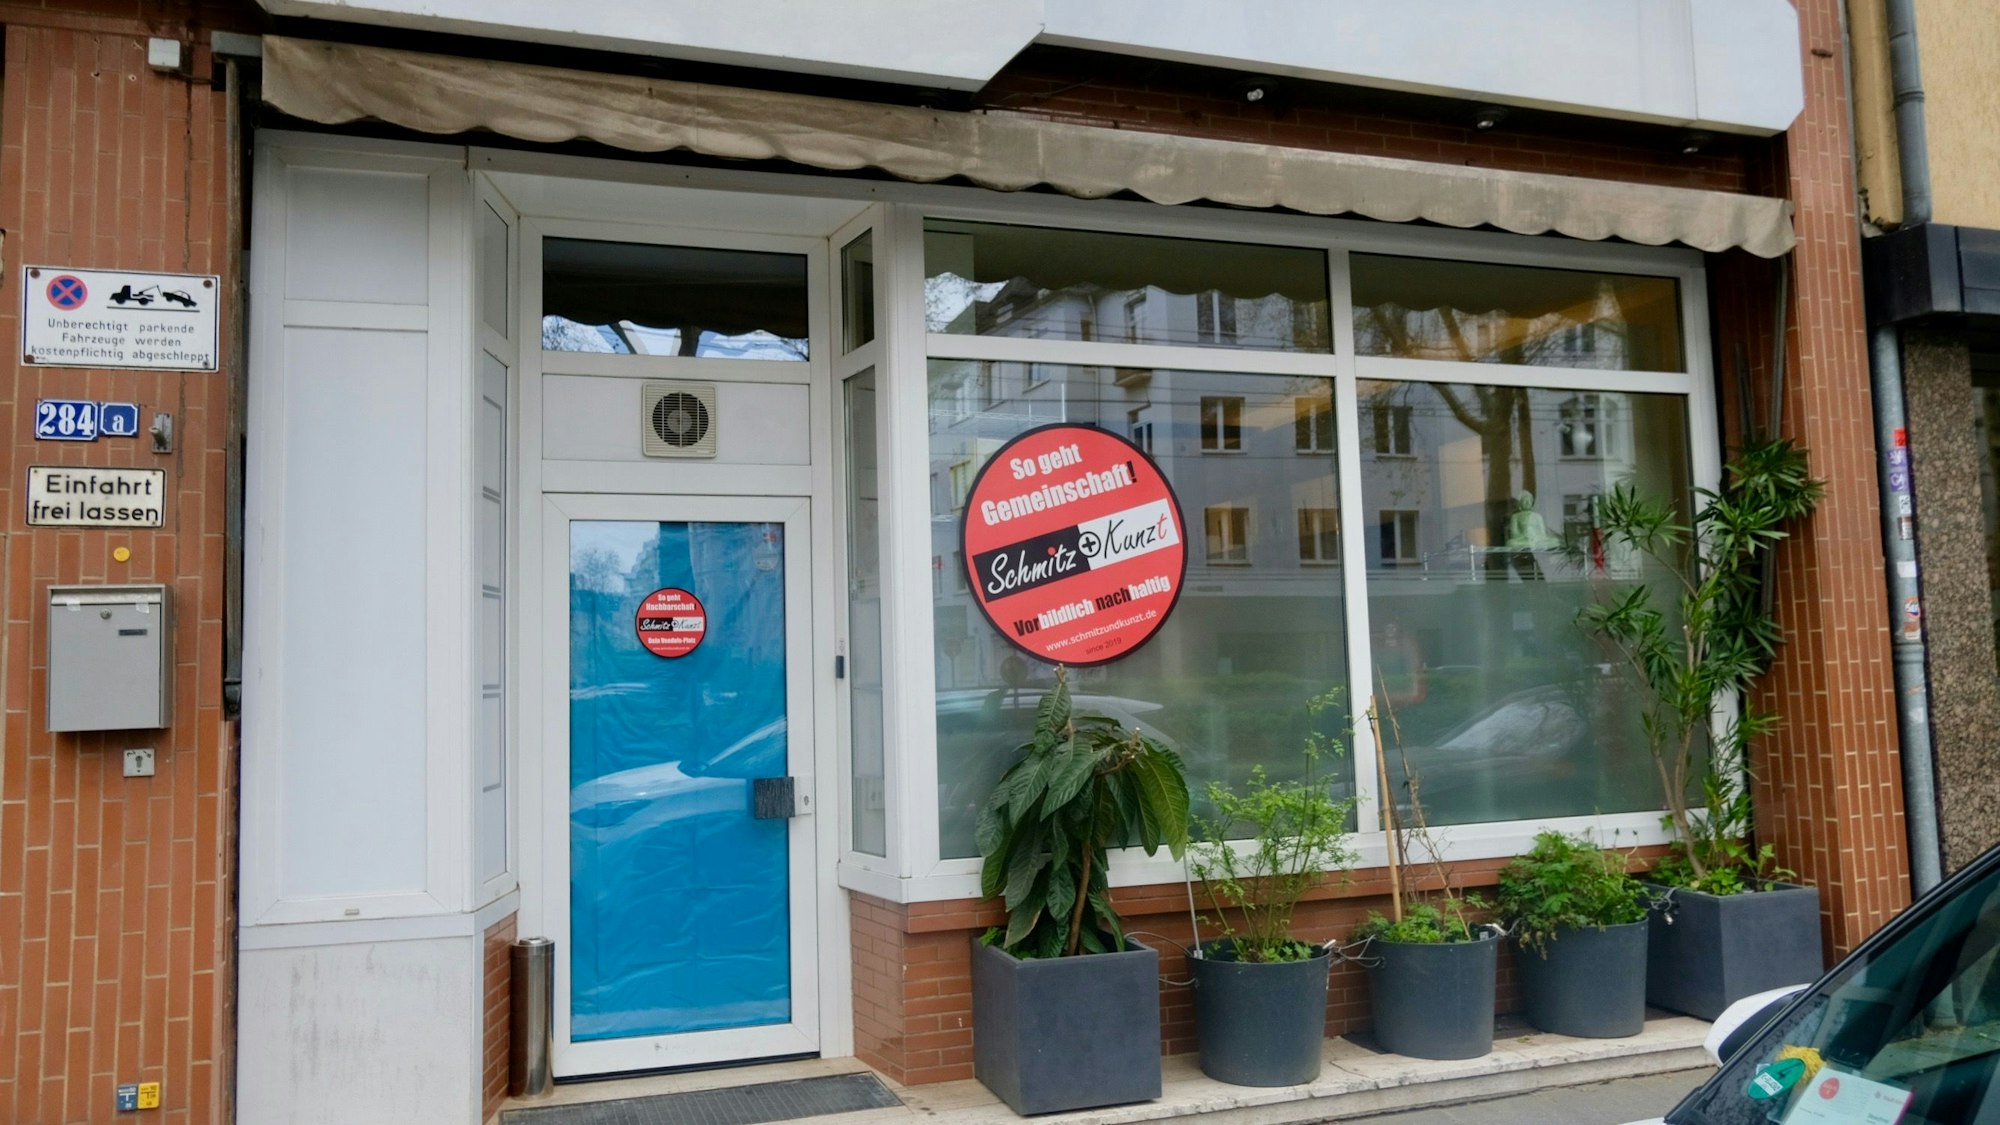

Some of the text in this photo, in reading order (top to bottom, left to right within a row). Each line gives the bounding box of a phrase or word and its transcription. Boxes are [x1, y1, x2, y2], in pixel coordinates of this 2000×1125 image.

[48, 318, 195, 334] Unberechtigt parkende
[62, 333, 181, 346] Fahrzeuge werden
[31, 345, 210, 363] kostenpflichtig abgeschleppt
[39, 404, 125, 435] 284 a
[1010, 443, 1083, 480] So geht
[46, 474, 152, 495] Einfahrt
[981, 460, 1138, 526] Gemeinschaft!
[33, 500, 158, 521] frei lassen
[987, 544, 1077, 595] Schmitz
[1103, 512, 1168, 559] Kunzt
[657, 594, 681, 602] So geht
[1013, 575, 1171, 637] Vorbildlich nachhaltig
[1045, 609, 1158, 652] www.schmitzundkunzt.de
[1085, 644, 1104, 656] since
